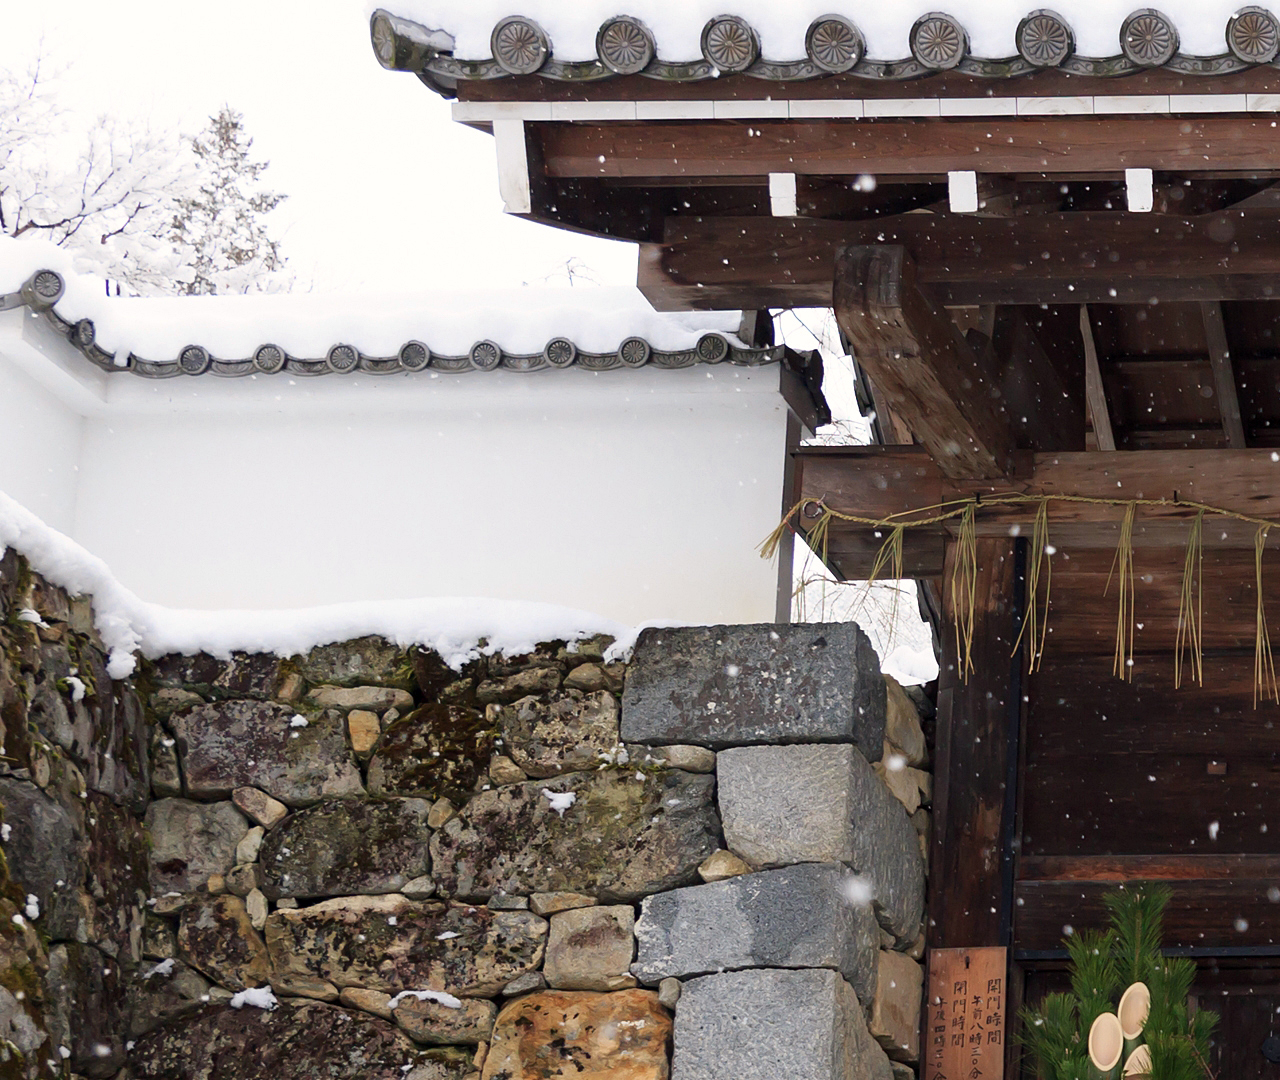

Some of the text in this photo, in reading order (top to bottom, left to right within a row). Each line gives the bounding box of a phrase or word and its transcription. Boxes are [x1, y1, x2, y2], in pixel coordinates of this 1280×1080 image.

[951, 980, 968, 1048] 閉門時間
[986, 978, 1002, 1045] 開門時間
